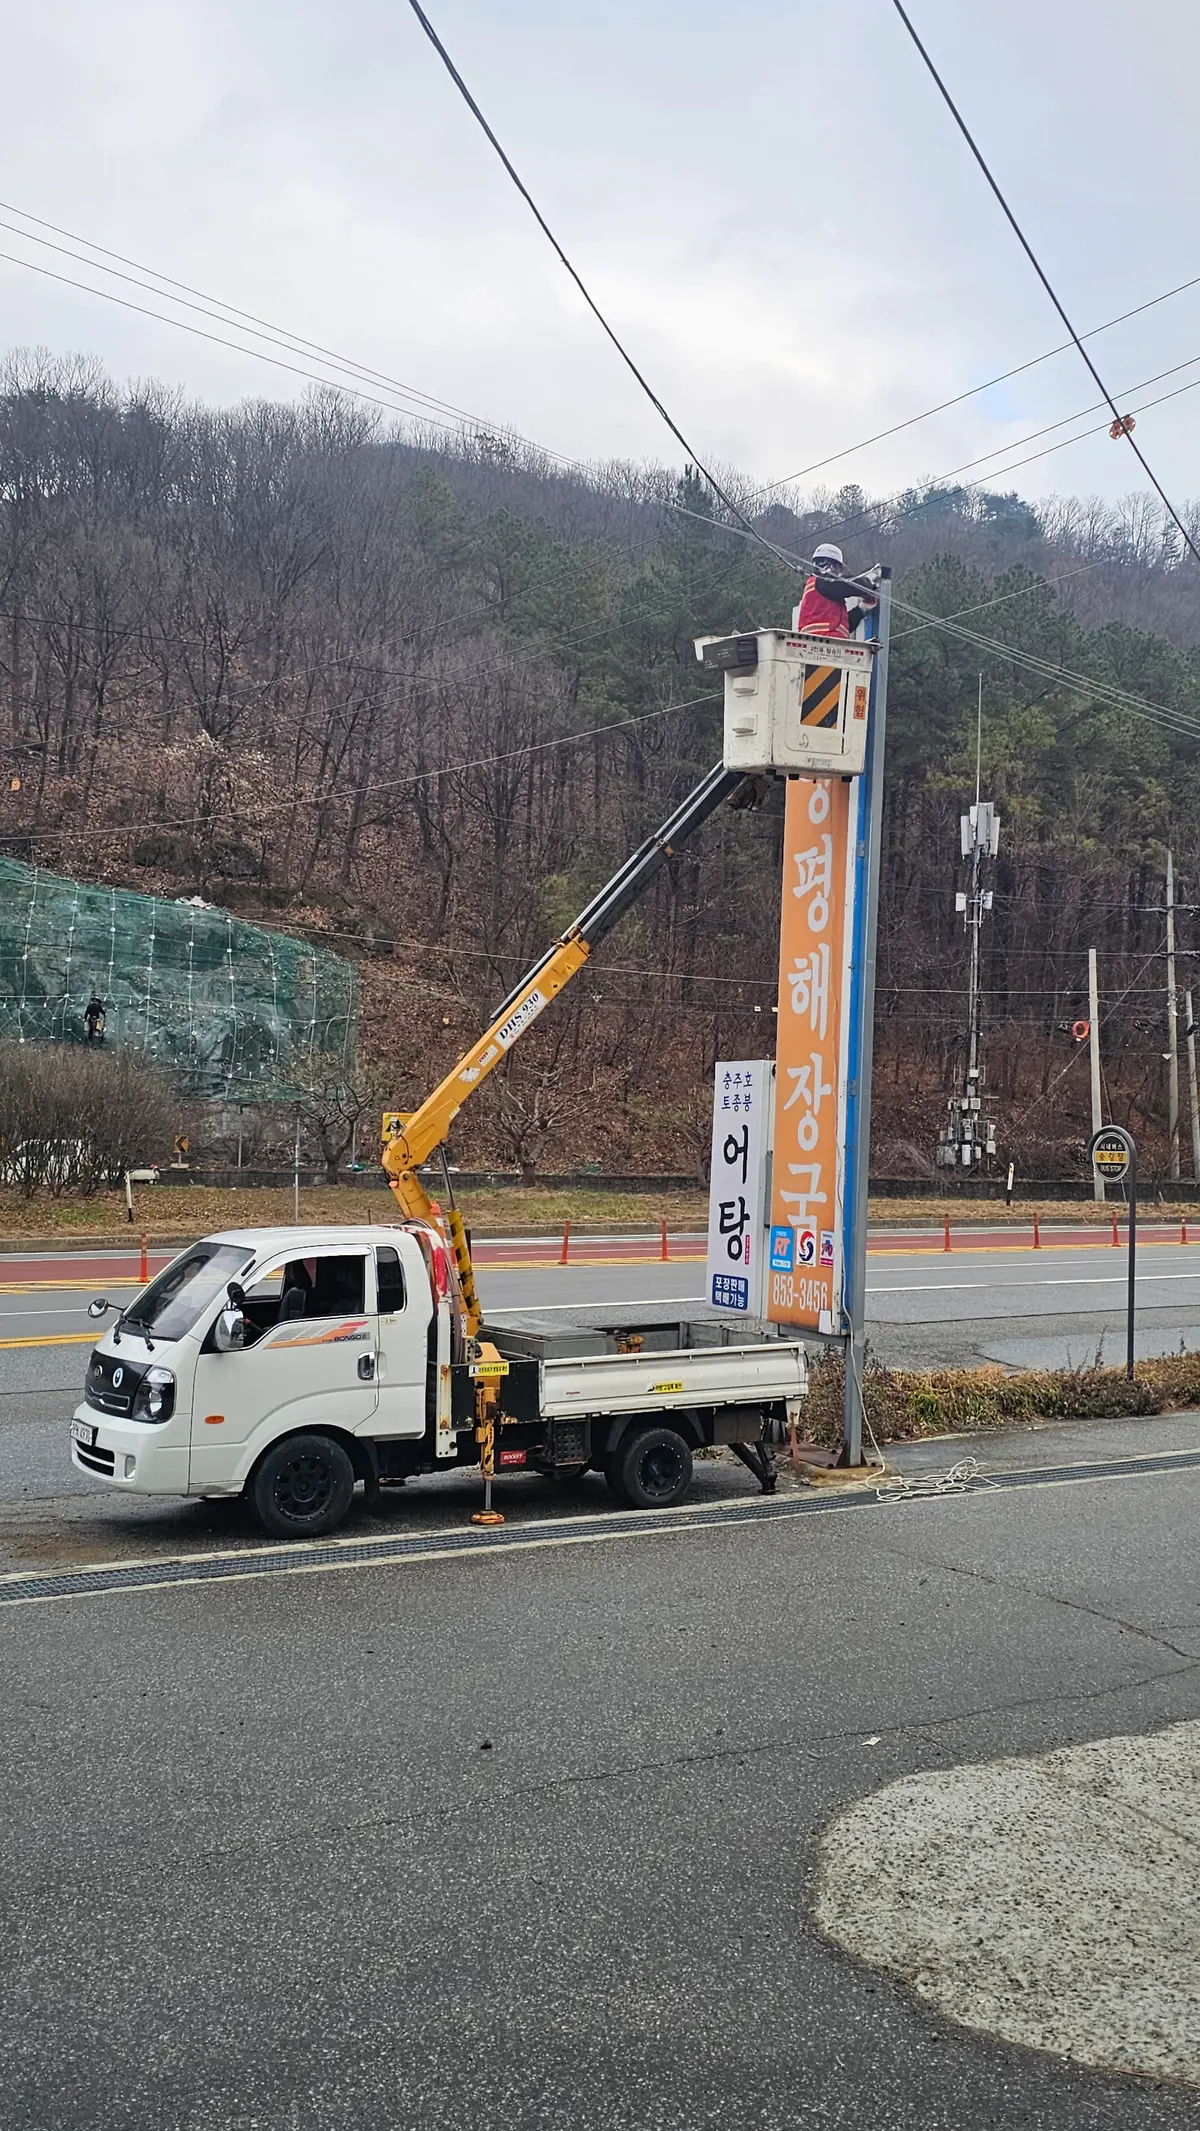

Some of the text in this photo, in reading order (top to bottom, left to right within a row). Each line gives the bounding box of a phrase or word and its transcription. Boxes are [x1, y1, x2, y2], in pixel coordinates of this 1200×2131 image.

[500, 1014, 522, 1039] DHS
[522, 993, 539, 1012] 930
[723, 1071, 753, 1090] 충주호
[722, 1093, 753, 1112] 토종붕
[1099, 1152, 1124, 1161] 승강장
[718, 1124, 753, 1262] 어탕
[715, 1276, 745, 1292] 포장판매
[773, 1274, 828, 1313] 853-3456
[715, 1290, 745, 1308] 택배가능
[333, 1334, 361, 1342] BONGO
